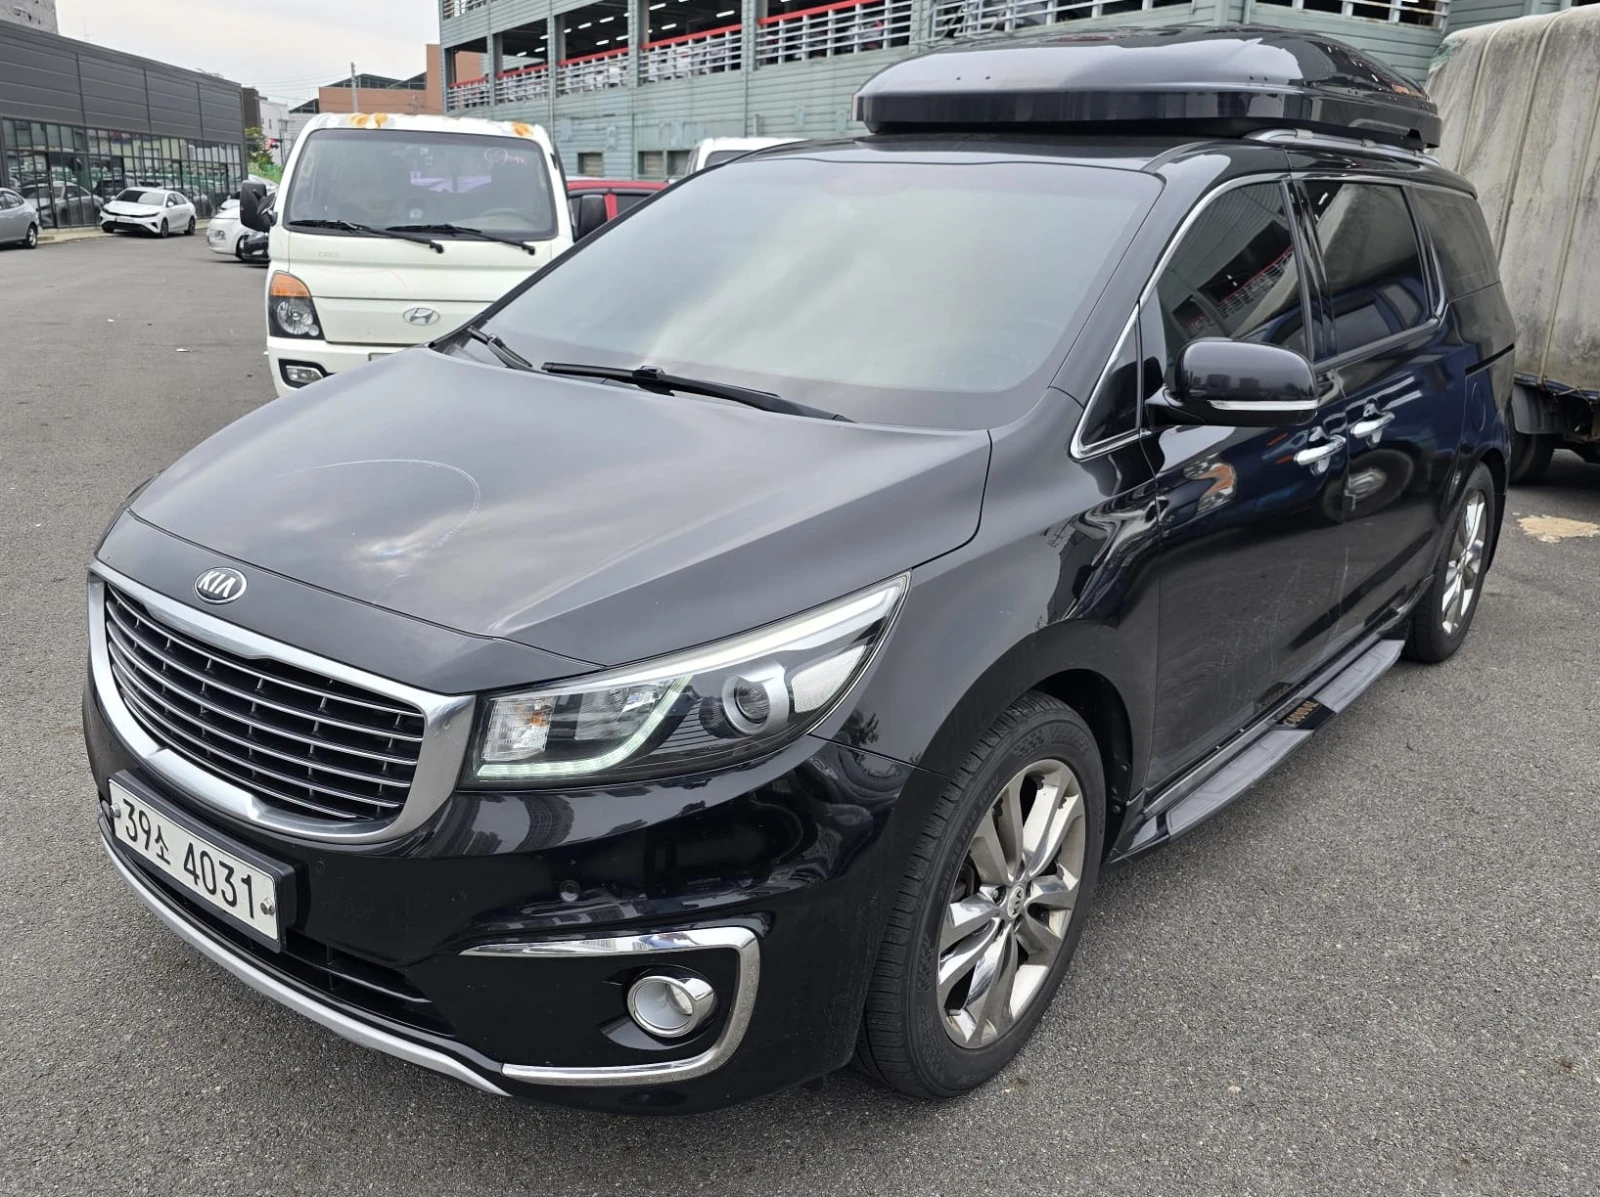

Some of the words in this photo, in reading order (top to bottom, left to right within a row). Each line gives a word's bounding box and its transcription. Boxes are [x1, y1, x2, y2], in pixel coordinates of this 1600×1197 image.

[198, 571, 237, 598] KIA
[123, 798, 171, 866] 39소
[183, 842, 255, 919] 4031
